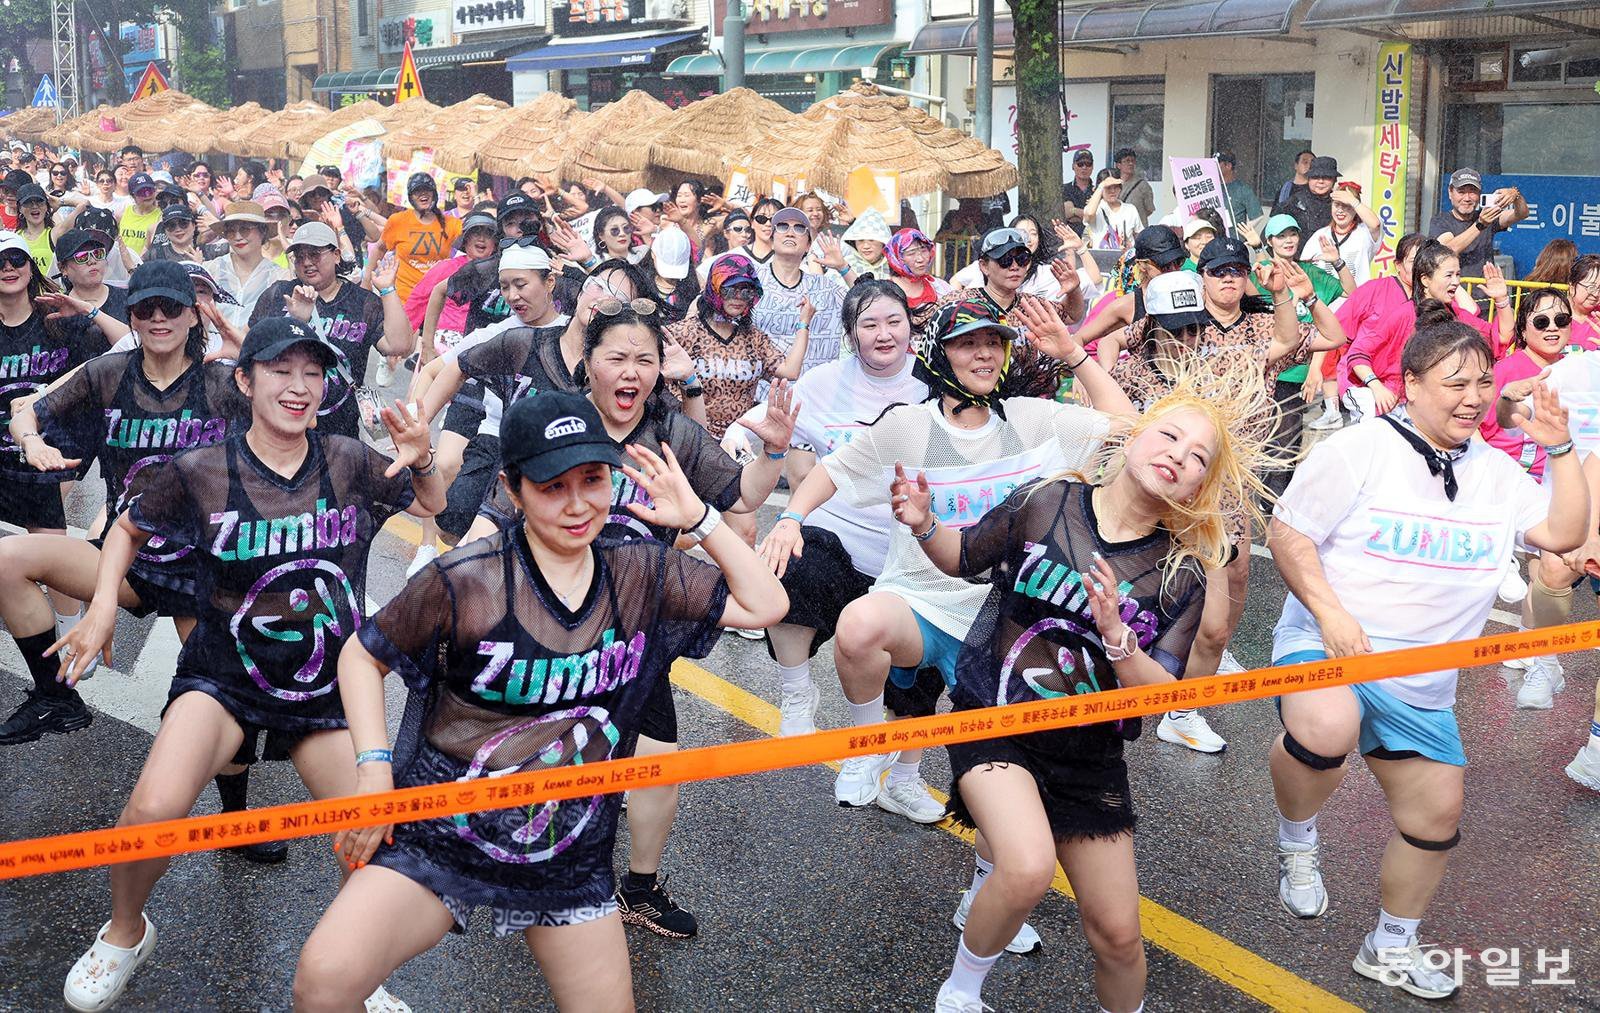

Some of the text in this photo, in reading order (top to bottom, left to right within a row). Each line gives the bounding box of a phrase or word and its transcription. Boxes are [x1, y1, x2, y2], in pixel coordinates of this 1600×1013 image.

[1375, 52, 1404, 279] 신발세탁·옷수
[1181, 178, 1216, 200] 모든것들을
[122, 228, 147, 240] ZUMB
[0, 345, 69, 379] mba
[104, 408, 226, 450] Zumba
[544, 417, 587, 440] emis
[209, 498, 358, 562] Zumba
[1366, 516, 1498, 564] ZUMBA
[470, 628, 645, 706] Zumba
[1309, 665, 1344, 682] 접근금지
[1261, 677, 1283, 688] away
[1284, 673, 1305, 685] Keep
[1083, 701, 1103, 715] LINE
[1104, 696, 1138, 713] SAFETY
[911, 729, 928, 739] Your
[931, 725, 955, 738] Watch
[959, 717, 994, 734] 추락주의
[891, 730, 910, 743] Step
[576, 775, 605, 787] Keep
[611, 764, 662, 783] 접근금지
[543, 779, 573, 791] away
[369, 793, 448, 816] 안전통로준수
[280, 814, 308, 831] LINE
[311, 807, 361, 823] SAFETY
[0, 837, 145, 868] 추락주의 Watch Your Ste
